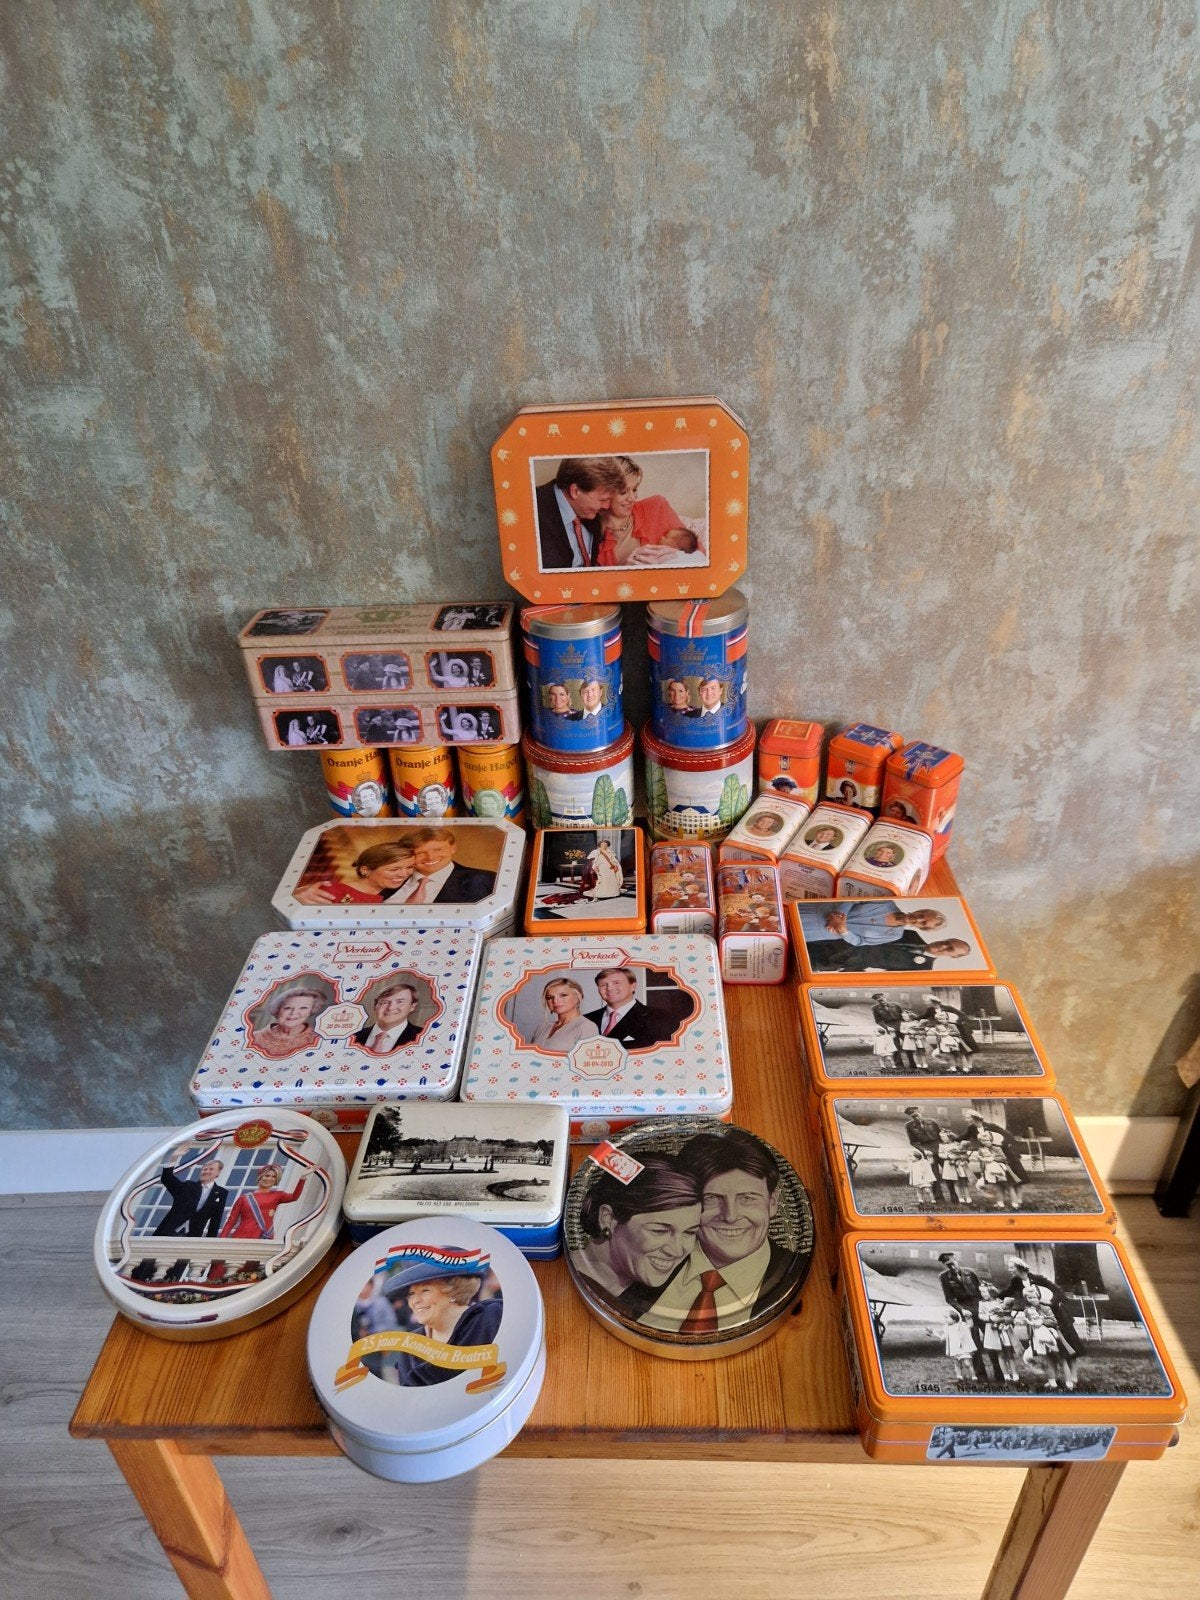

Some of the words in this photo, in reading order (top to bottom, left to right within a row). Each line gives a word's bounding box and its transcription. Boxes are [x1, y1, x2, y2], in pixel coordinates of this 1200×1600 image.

[327, 757, 363, 768] Oranje
[396, 757, 431, 770] Oranje
[344, 945, 383, 954] Verkade
[579, 951, 619, 960] Verkade
[402, 1246, 468, 1267] 1980-2005
[361, 1336, 376, 1351] 25
[376, 1335, 401, 1350] jaar
[401, 1334, 449, 1361] Koningin
[450, 1347, 493, 1363] Beatrix
[915, 1384, 940, 1393] 1945
[957, 1384, 1010, 1393] Nederland
